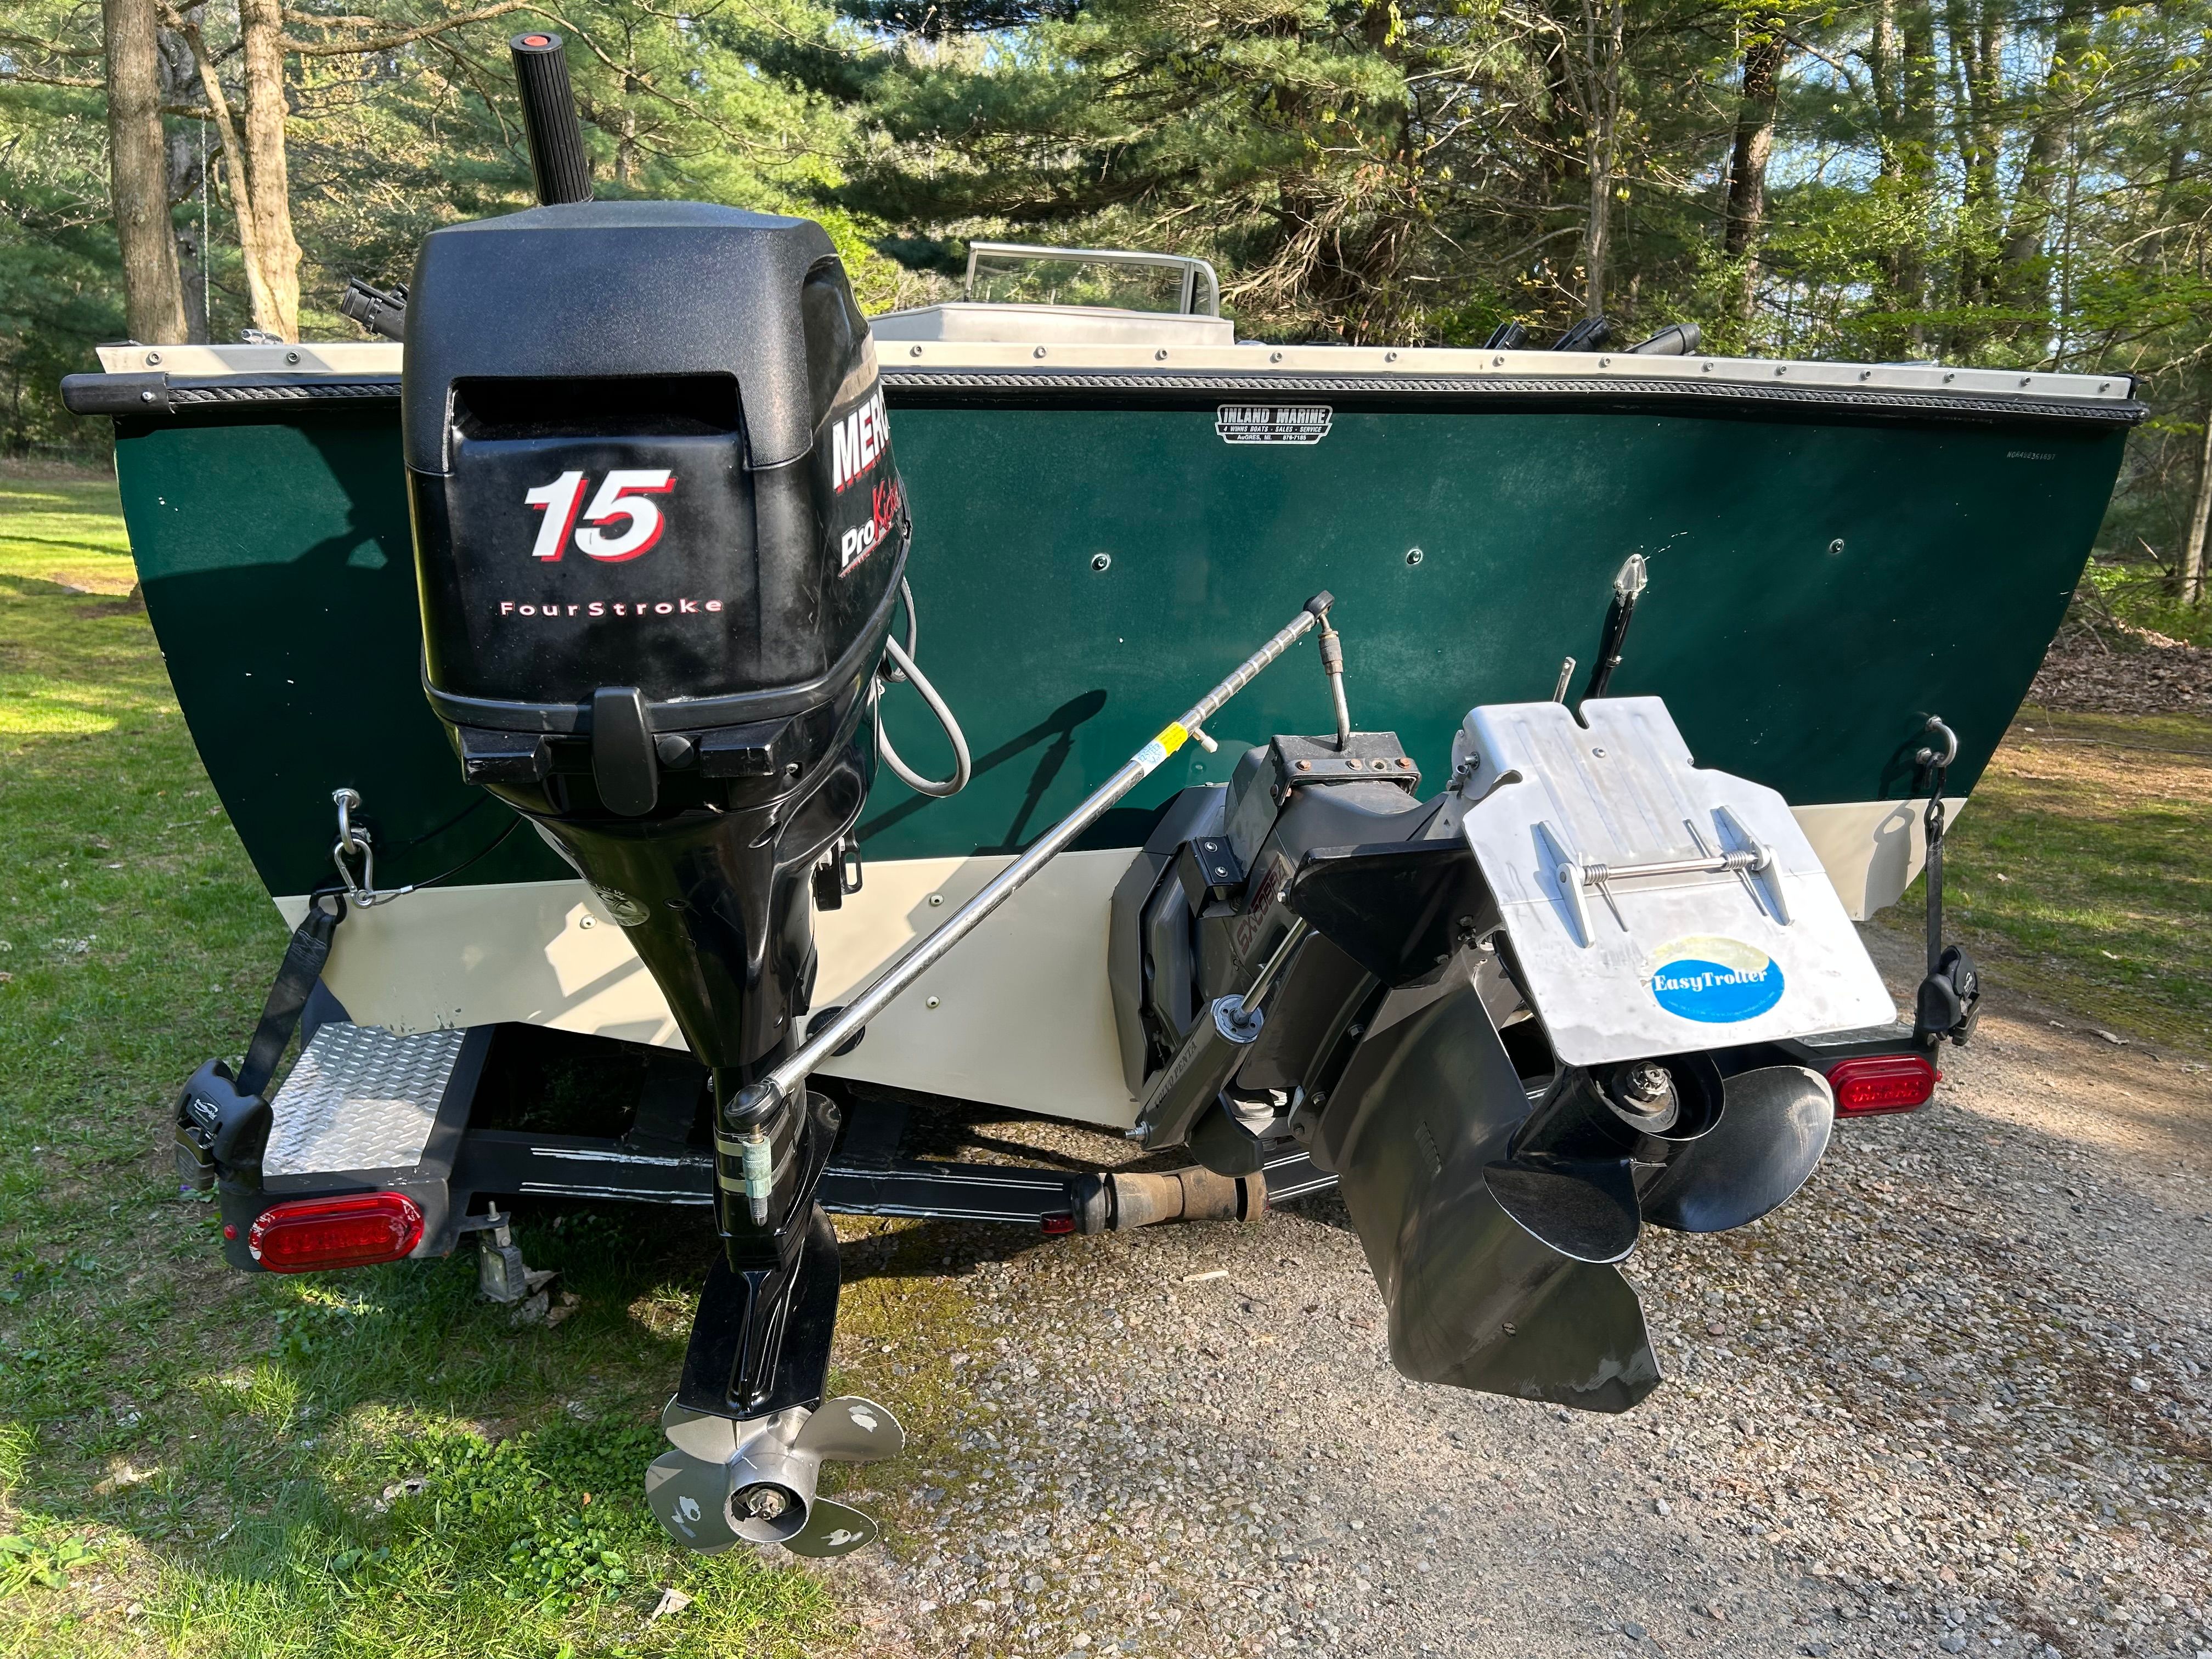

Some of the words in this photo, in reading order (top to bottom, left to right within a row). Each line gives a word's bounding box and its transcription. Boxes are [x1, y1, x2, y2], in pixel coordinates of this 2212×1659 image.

[1223, 408, 1269, 423] INLAND
[1277, 408, 1325, 424] MARINE
[524, 469, 677, 563] 15
[500, 599, 724, 618] FourStroke
[1653, 969, 1768, 992] EasyTroller
[1175, 1041, 1197, 1080] PENTA
